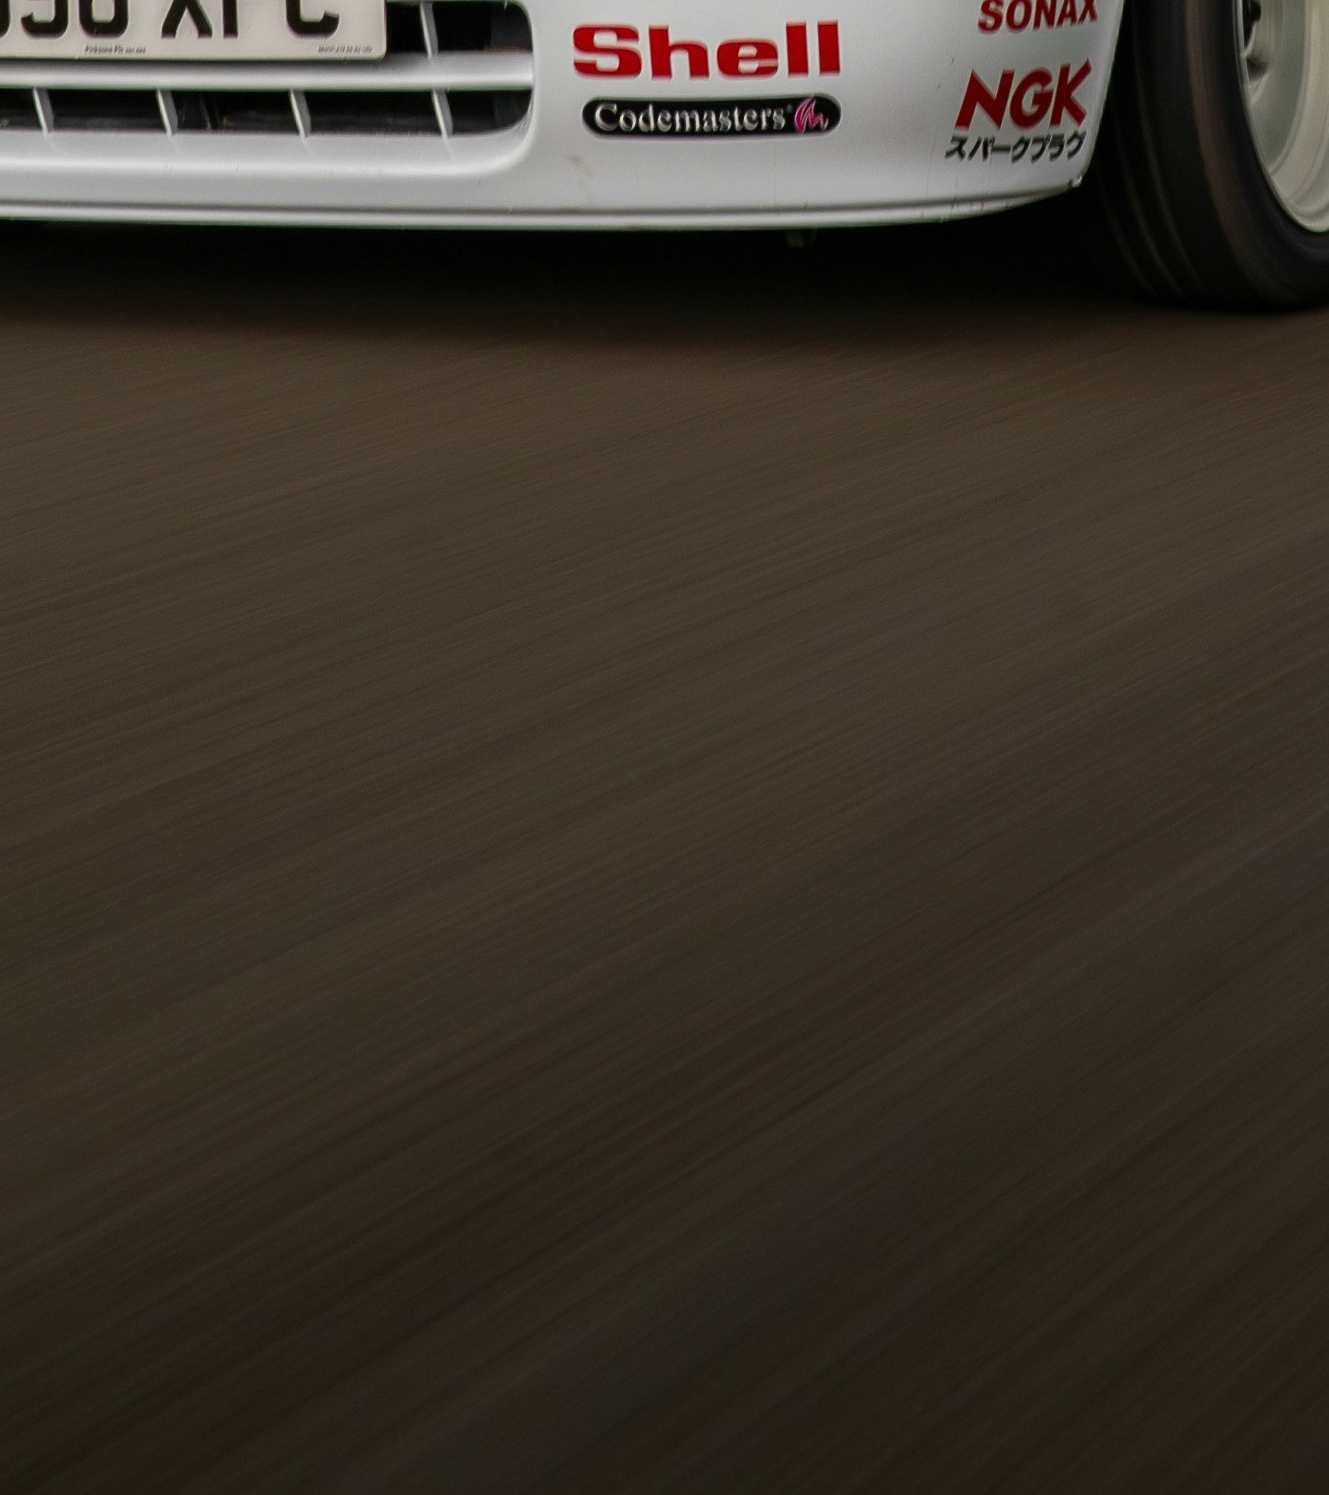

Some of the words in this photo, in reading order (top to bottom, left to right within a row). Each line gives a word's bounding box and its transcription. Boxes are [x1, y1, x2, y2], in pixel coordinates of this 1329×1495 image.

[572, 21, 840, 80] Shell
[594, 102, 787, 132] Codemasters
[954, 58, 1093, 131] NGK
